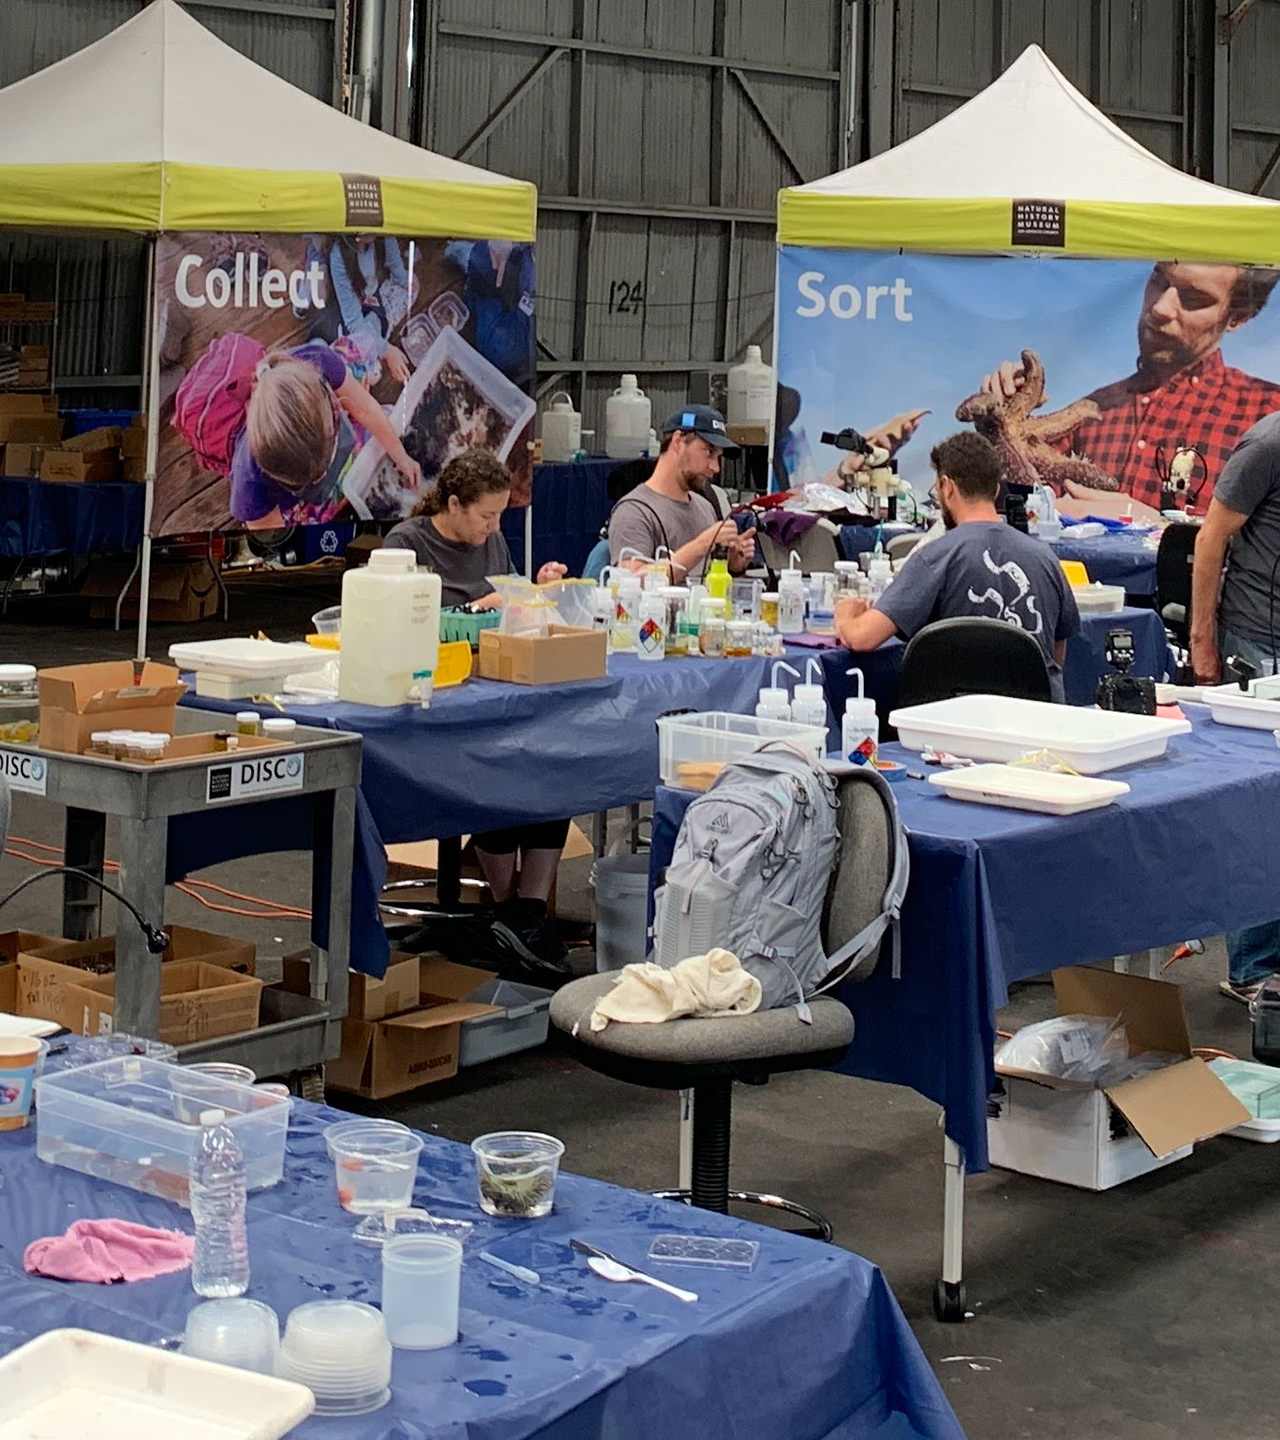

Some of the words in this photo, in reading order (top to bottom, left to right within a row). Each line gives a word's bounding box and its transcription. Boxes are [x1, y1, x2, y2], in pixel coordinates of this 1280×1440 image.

[174, 251, 326, 309] Collect
[609, 280, 643, 315] 124
[795, 271, 914, 322] Sort
[241, 755, 301, 785] DISCO
